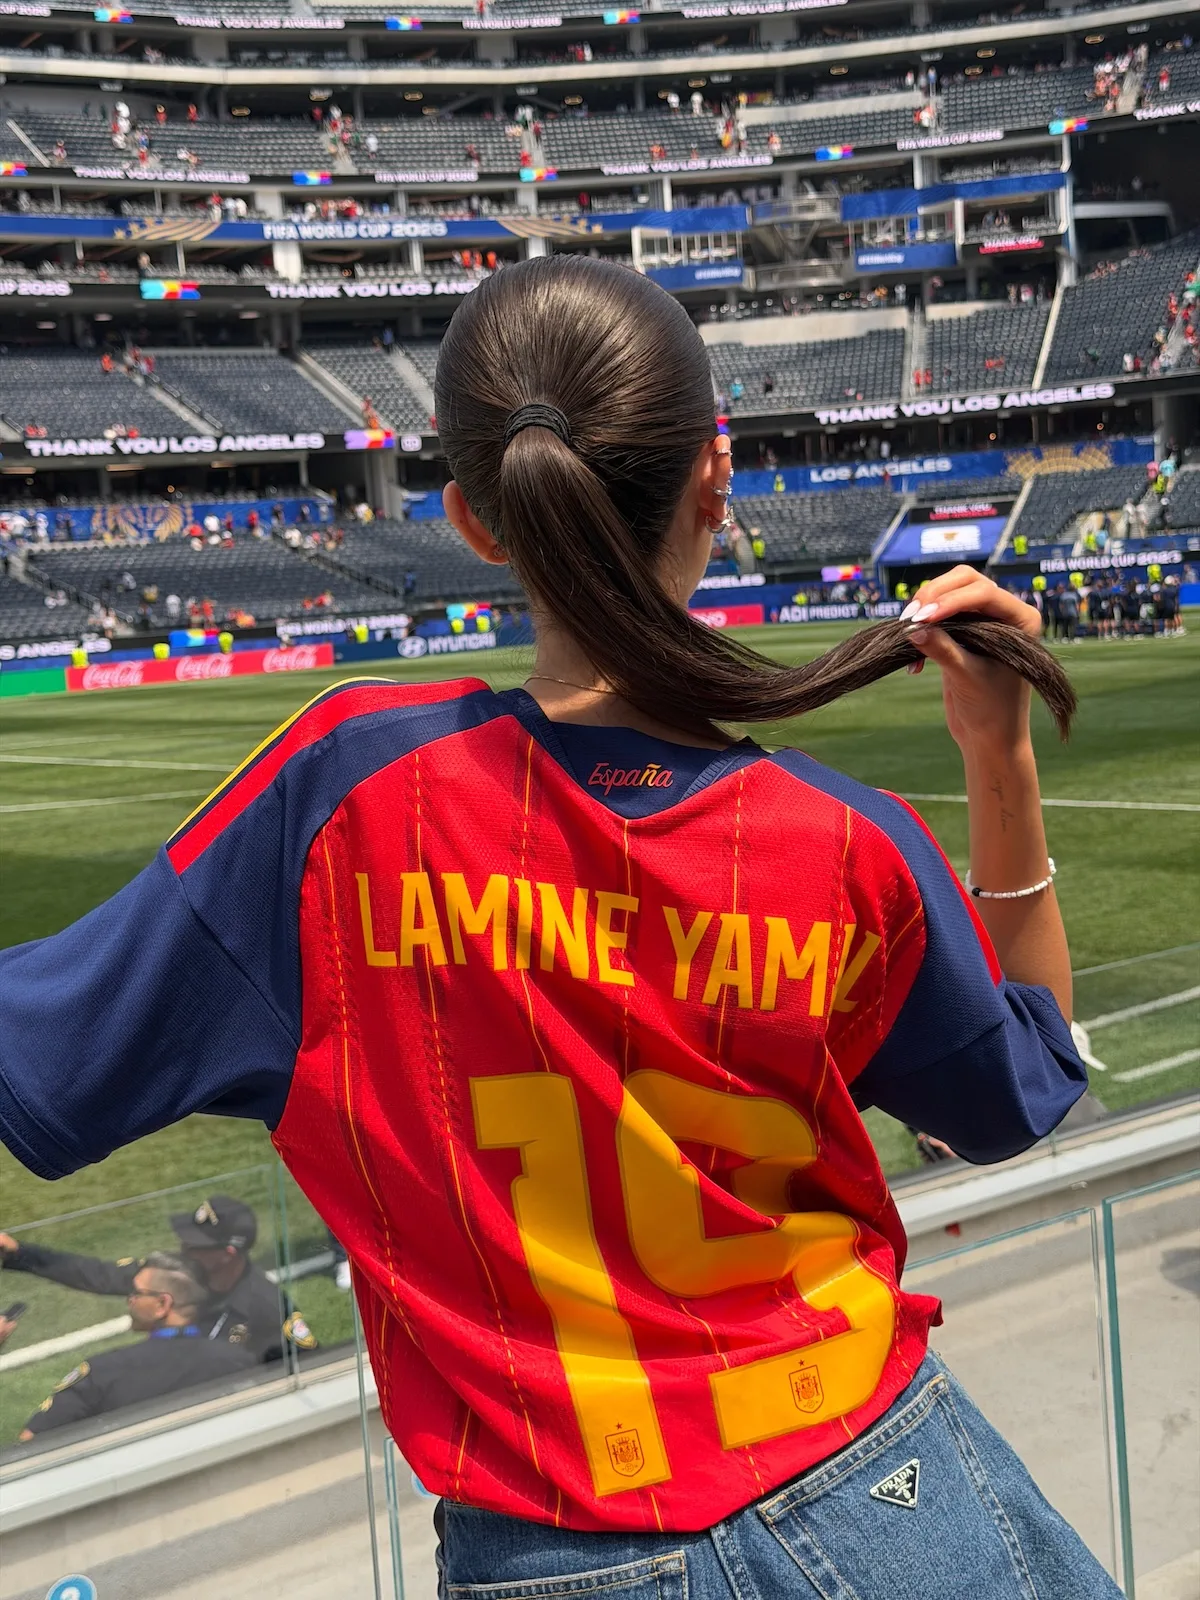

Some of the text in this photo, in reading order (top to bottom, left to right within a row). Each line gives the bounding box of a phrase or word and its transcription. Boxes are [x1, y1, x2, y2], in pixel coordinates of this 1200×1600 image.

[263, 223, 299, 239] FIFA
[299, 223, 357, 239] WORLD
[358, 223, 390, 238] CUP
[265, 283, 341, 298] THANK
[341, 283, 388, 297] YOU
[389, 281, 433, 296] LOS
[815, 383, 1115, 425] THANK YOU LOS ANGELES
[25, 433, 325, 456] THANK YOU LOS ANGELES
[810, 457, 952, 483] LOS ANGELES
[1067, 555, 1111, 571] WORLD
[1111, 553, 1136, 568] CUP
[780, 605, 809, 622] ADI
[428, 632, 496, 654] HYUNDAI
[176, 653, 234, 681] Coca-Cola
[262, 645, 318, 673] Coca-Cola
[82, 661, 143, 690] Coca-Cola
[588, 763, 673, 796] España
[355, 872, 639, 987] LAMINE
[469, 1069, 895, 1497] 19
[881, 1468, 914, 1494] PRADA
